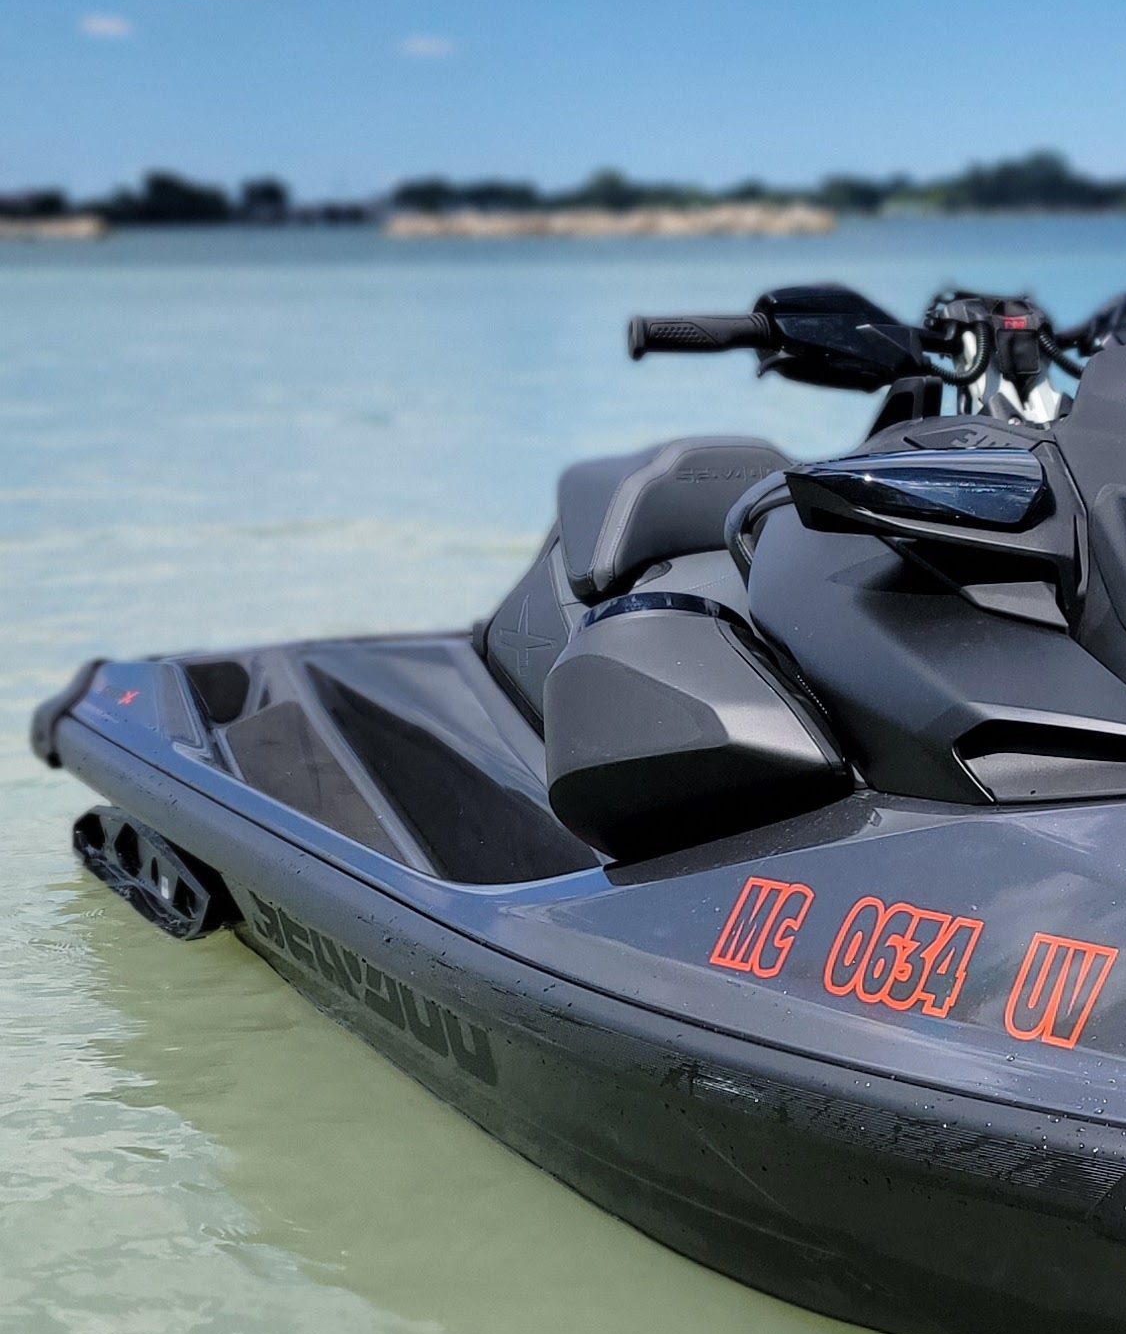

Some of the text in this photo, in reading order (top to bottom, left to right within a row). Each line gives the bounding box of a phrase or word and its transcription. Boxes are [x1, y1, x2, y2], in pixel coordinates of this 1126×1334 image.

[709, 876, 1120, 1049] MC 0634 UV
